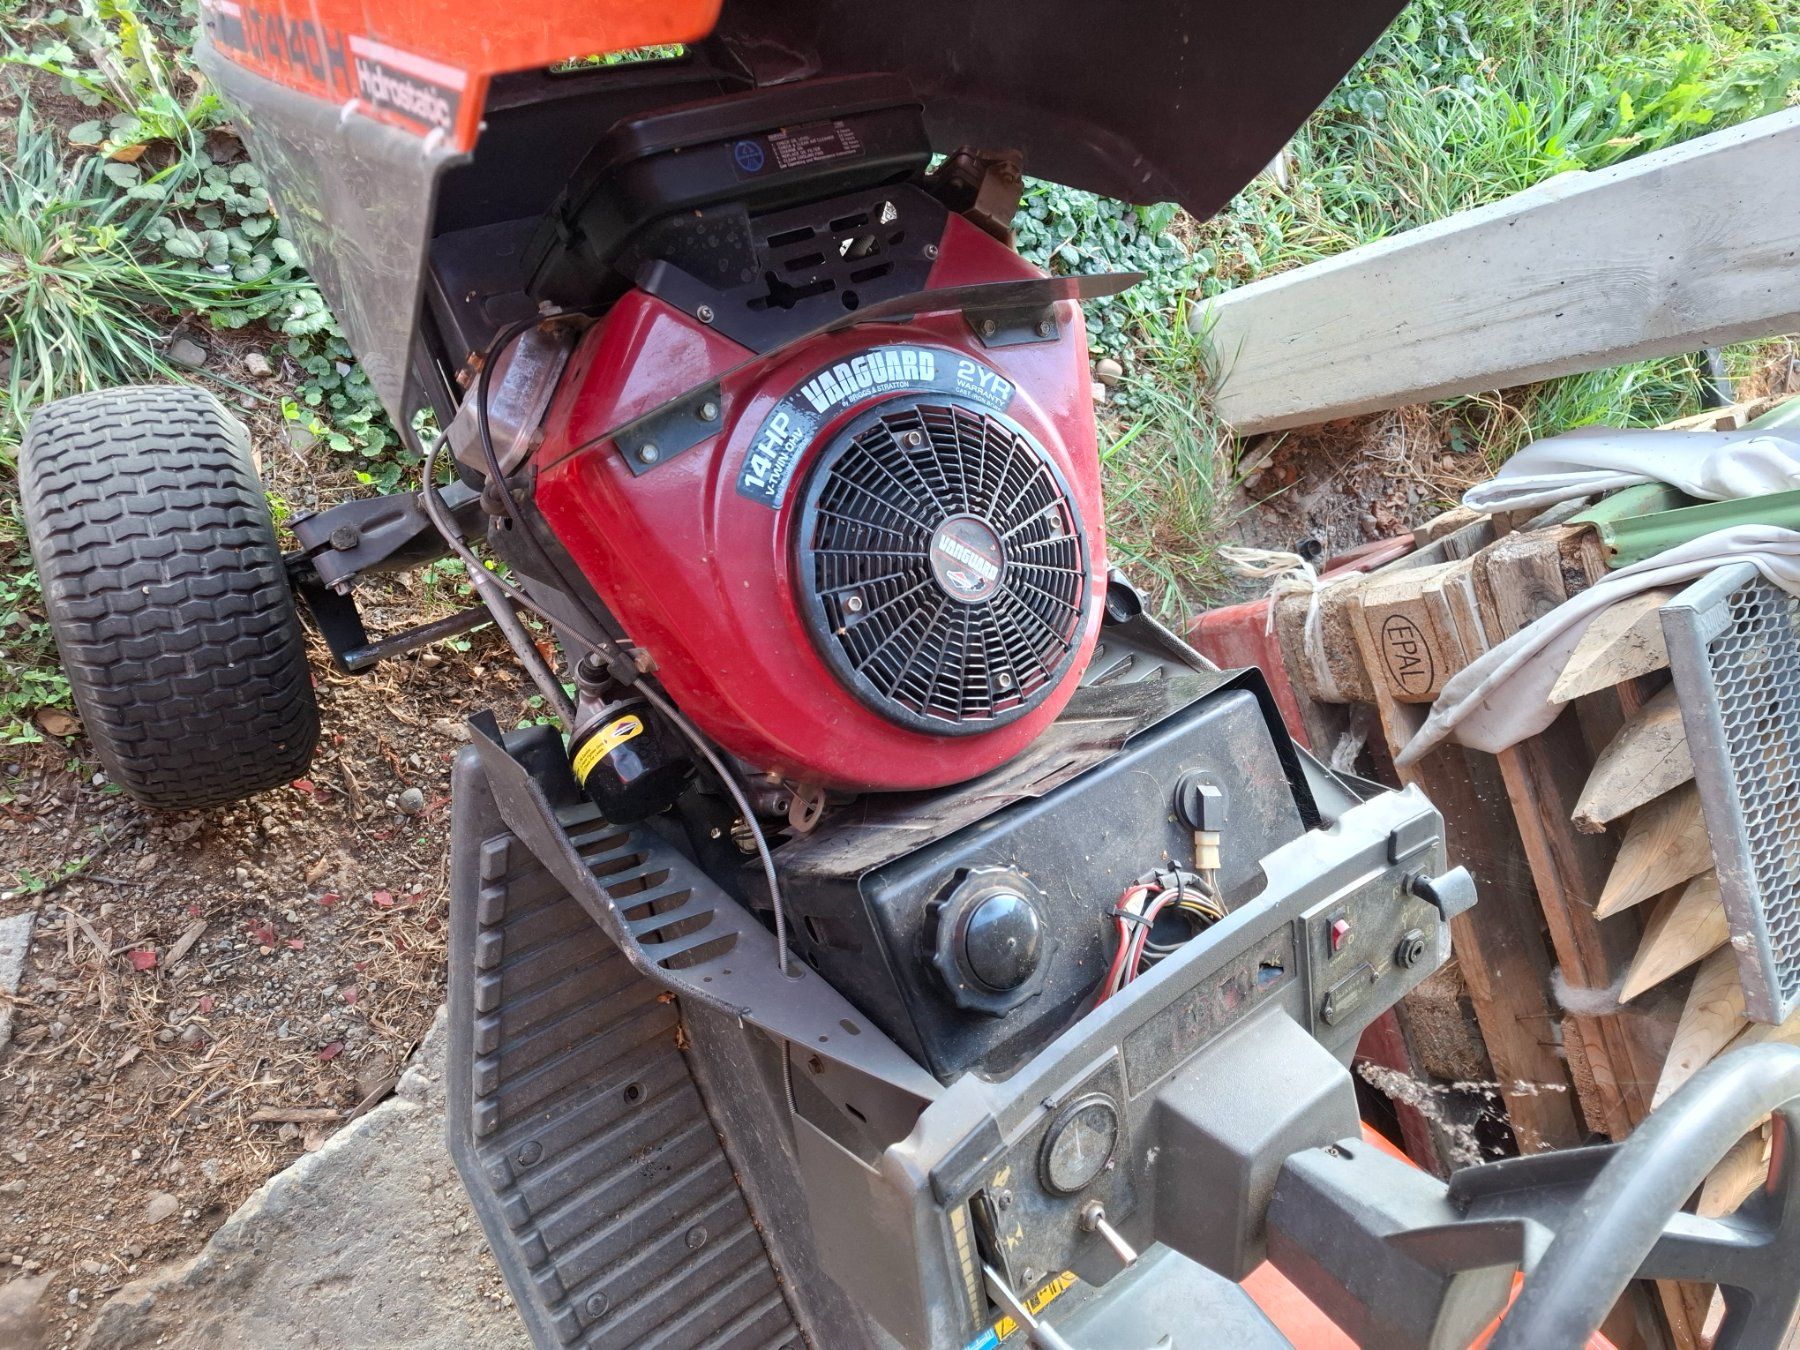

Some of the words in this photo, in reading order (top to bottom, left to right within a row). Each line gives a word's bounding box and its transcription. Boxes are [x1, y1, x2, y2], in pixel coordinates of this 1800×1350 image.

[801, 351, 935, 413] VANGUARD
[849, 388, 871, 402] BRIGGS
[877, 381, 909, 392] STRATTON
[957, 360, 1011, 400] 2YR
[957, 379, 1005, 406] WARRANTY
[745, 413, 790, 488] 14HP
[765, 452, 788, 495] V-TWIN
[785, 427, 803, 452] OHV
[939, 534, 998, 580] VANGUARD
[1387, 626, 1424, 684] EPAL
